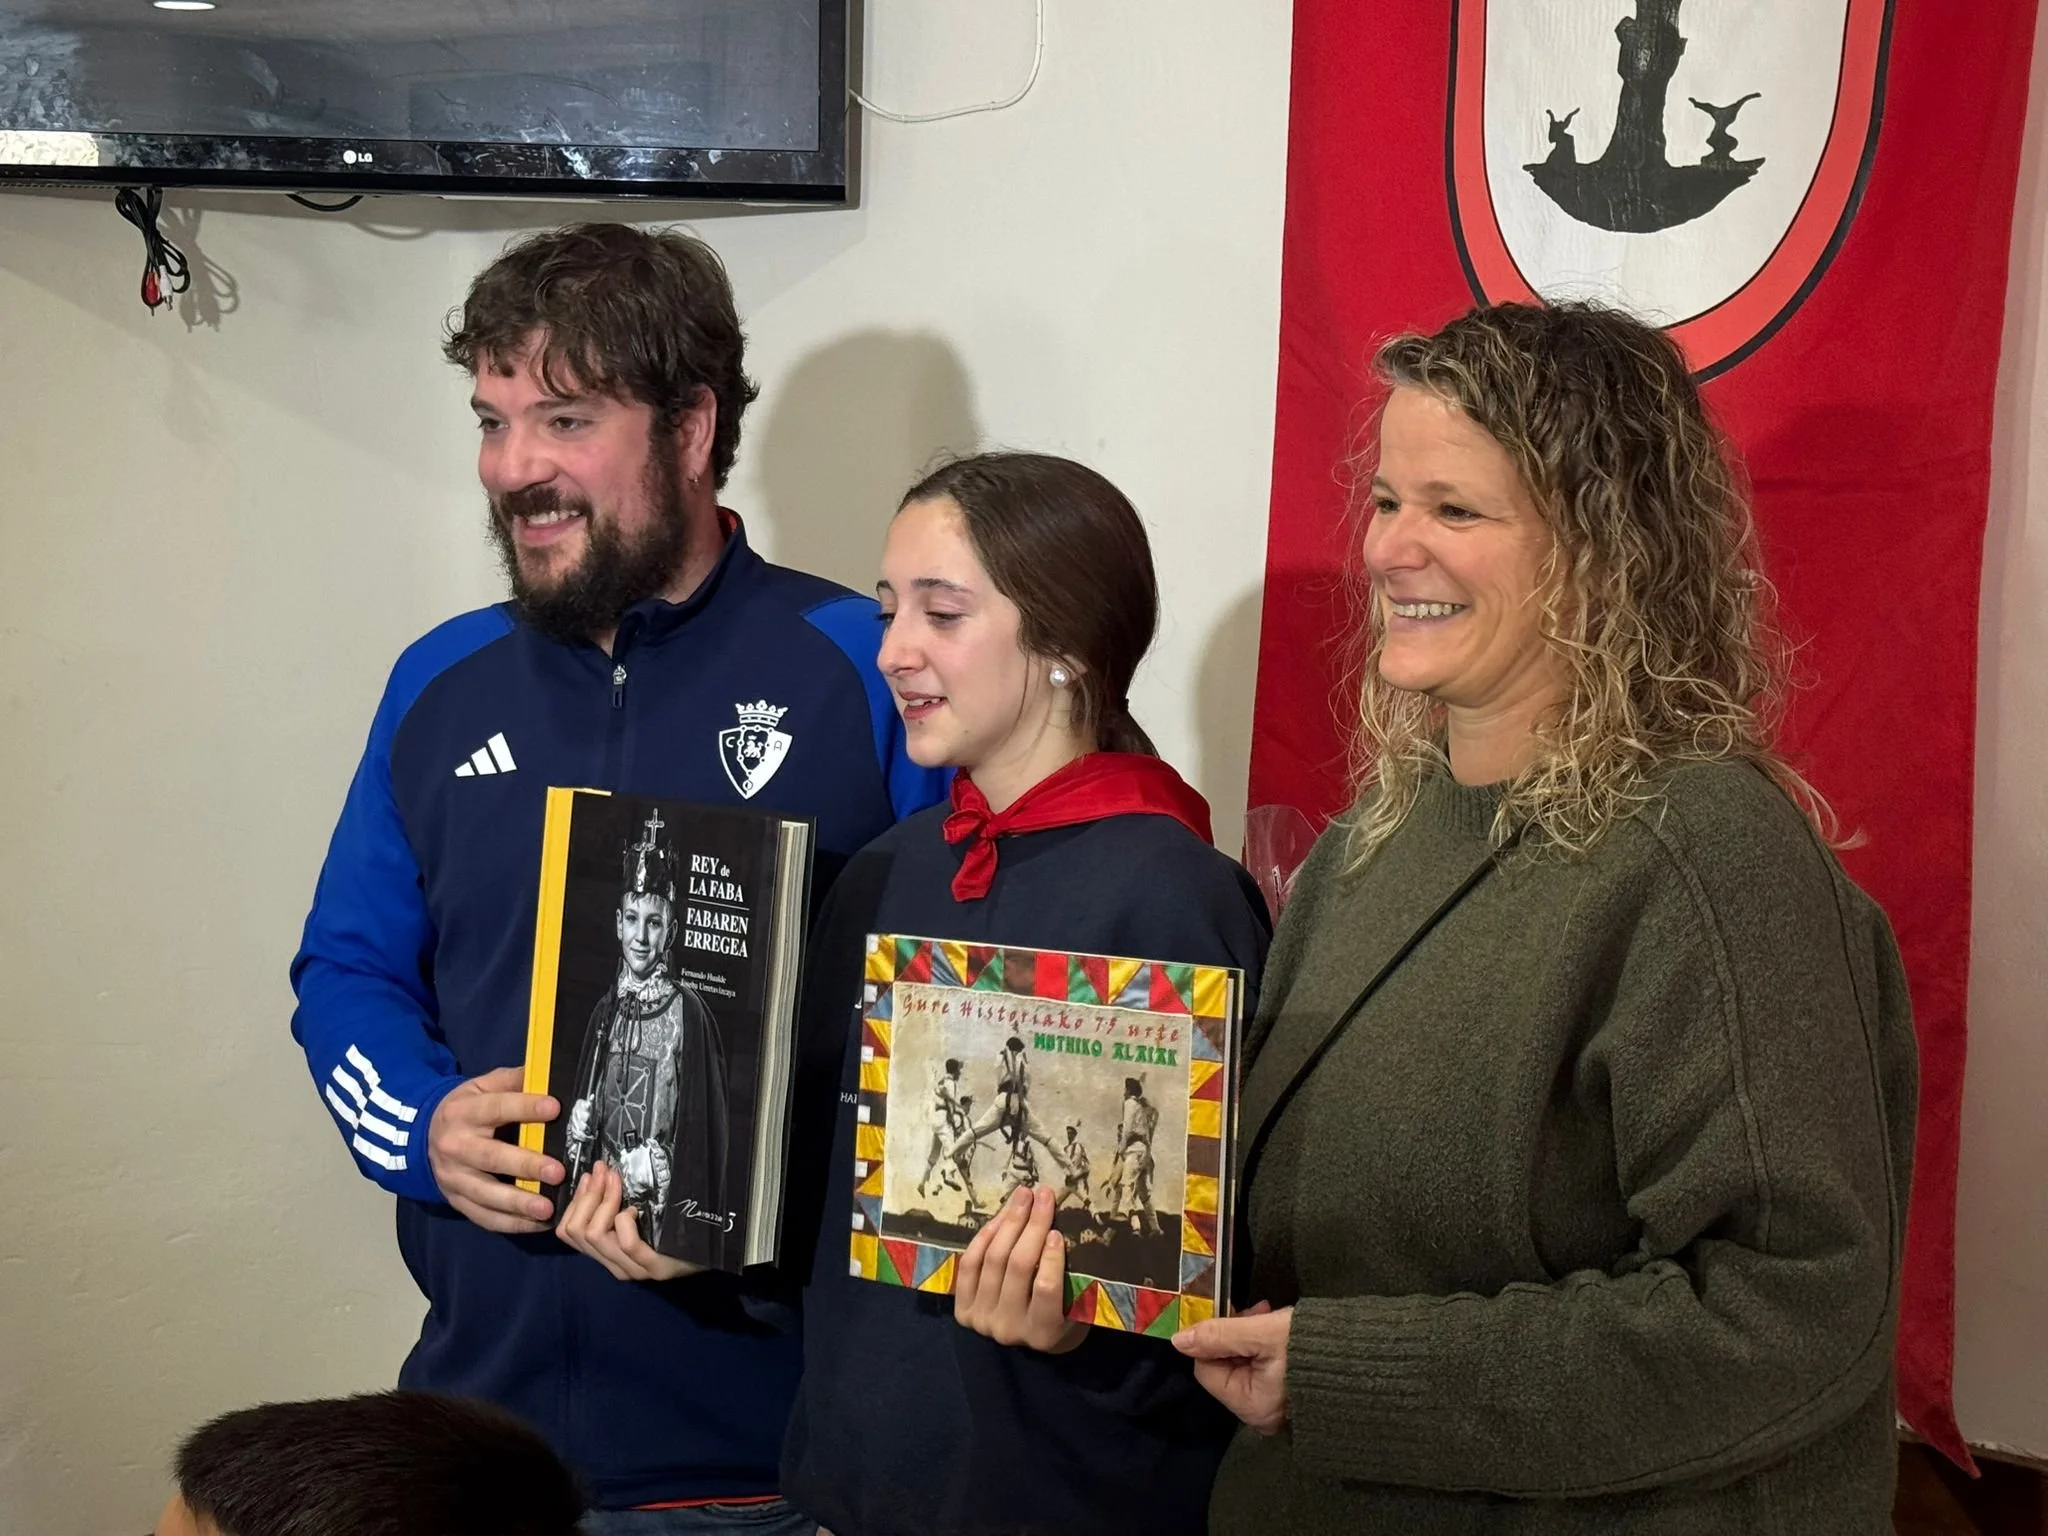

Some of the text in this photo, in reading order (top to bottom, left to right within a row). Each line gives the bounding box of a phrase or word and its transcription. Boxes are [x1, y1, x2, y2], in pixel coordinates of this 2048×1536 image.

[358, 152, 373, 163] LG
[691, 854, 731, 878] REY de
[688, 876, 744, 903] LA FABA
[685, 907, 749, 936] FABAREN
[684, 929, 748, 958] ERREGEA
[1033, 1032, 1178, 1067] MUTHIKO ALAIAK
